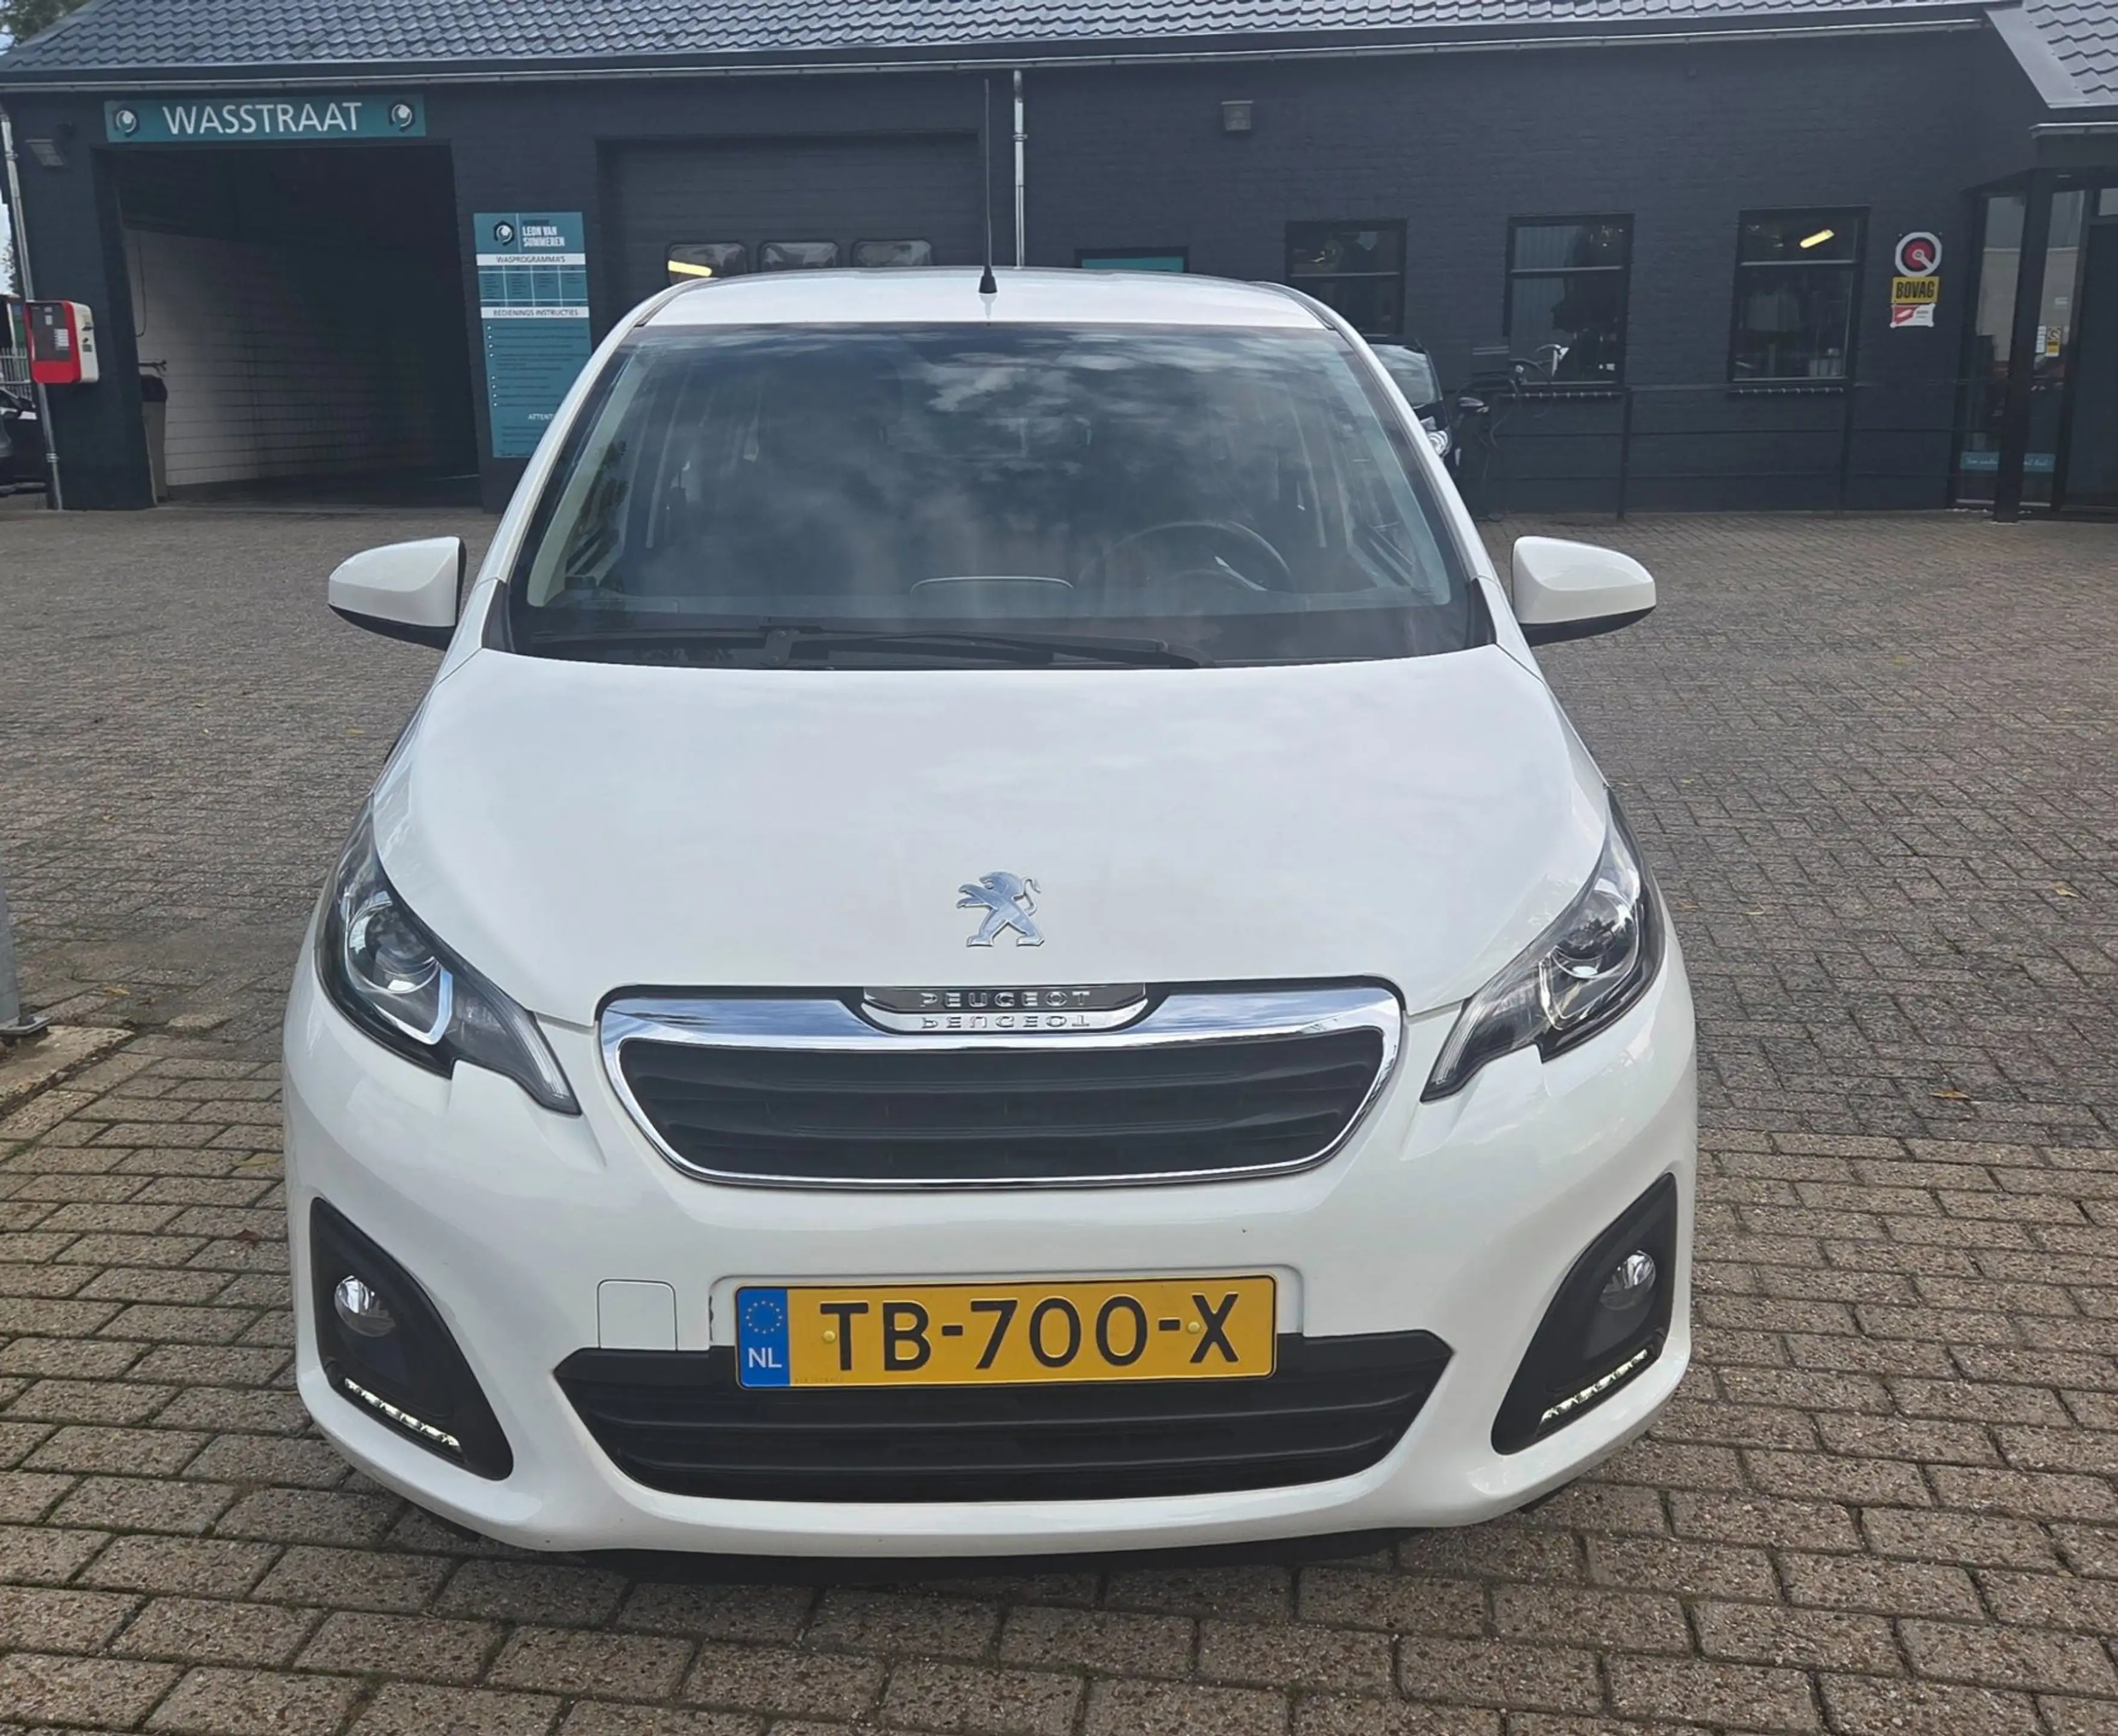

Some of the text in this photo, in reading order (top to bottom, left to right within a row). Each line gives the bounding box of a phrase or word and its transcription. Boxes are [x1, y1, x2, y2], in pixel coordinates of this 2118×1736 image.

[162, 102, 362, 134] WASSTRAAT
[1896, 280, 1935, 298] BOVAG
[920, 990, 1090, 1007] PEUGEOT
[820, 1293, 1240, 1372] TB-700-X
[748, 1347, 782, 1368] NL
